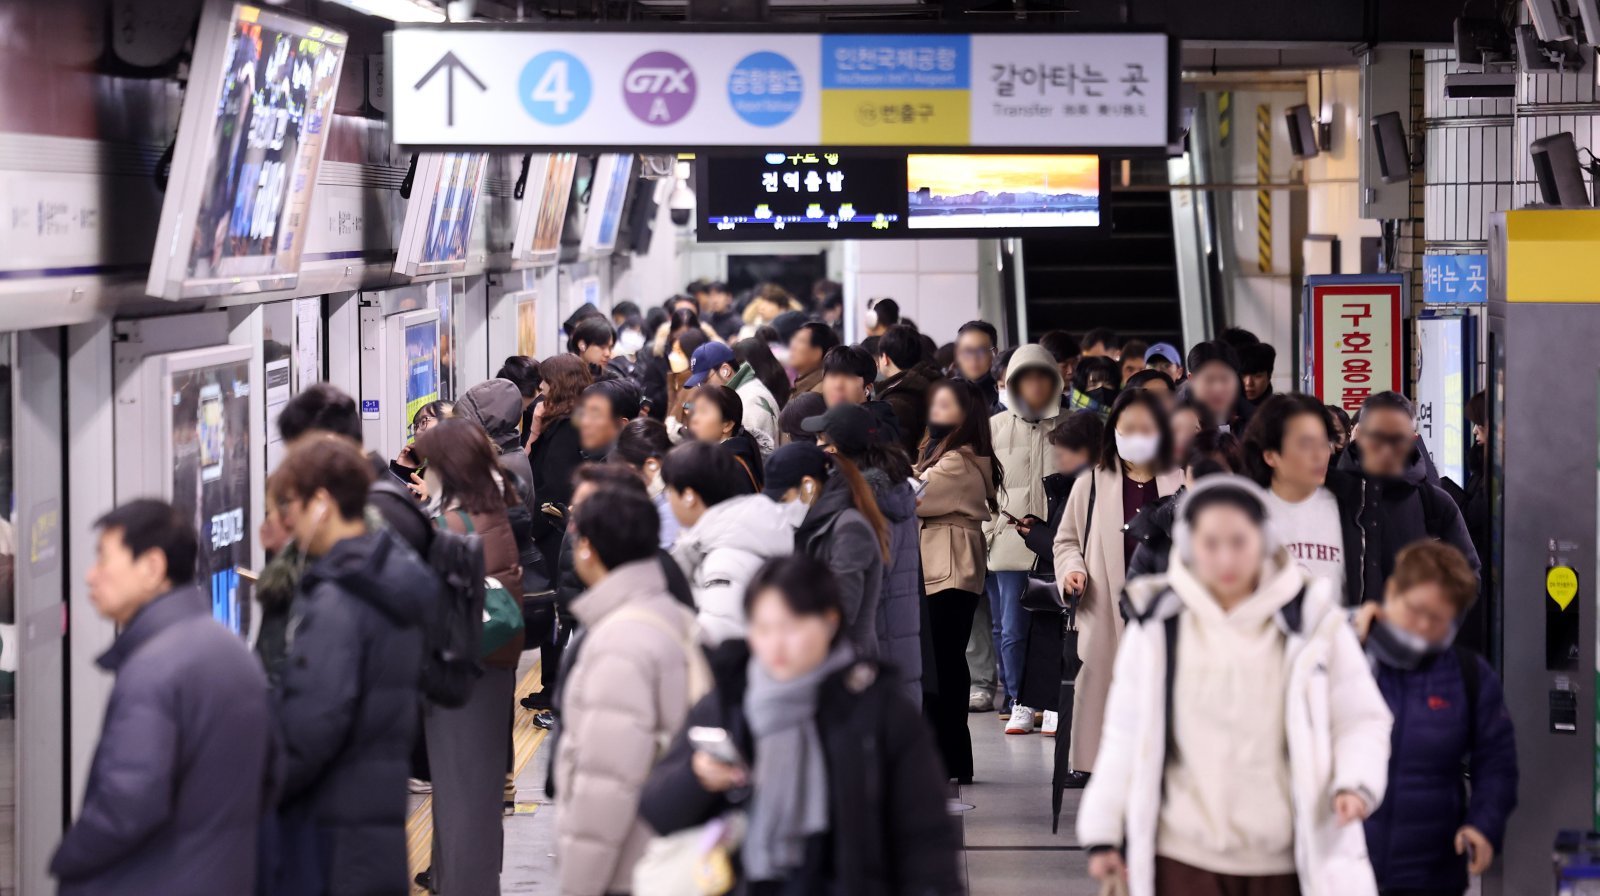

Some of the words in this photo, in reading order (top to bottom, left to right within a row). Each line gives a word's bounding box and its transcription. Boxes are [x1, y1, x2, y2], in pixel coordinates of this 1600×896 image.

[531, 60, 574, 115] 4
[625, 67, 691, 93] GTX
[990, 63, 1108, 97] 갈아타는
[1120, 63, 1149, 97] 곳
[648, 98, 670, 121] A
[992, 103, 1054, 117] Transfer
[1466, 264, 1485, 292] 곳
